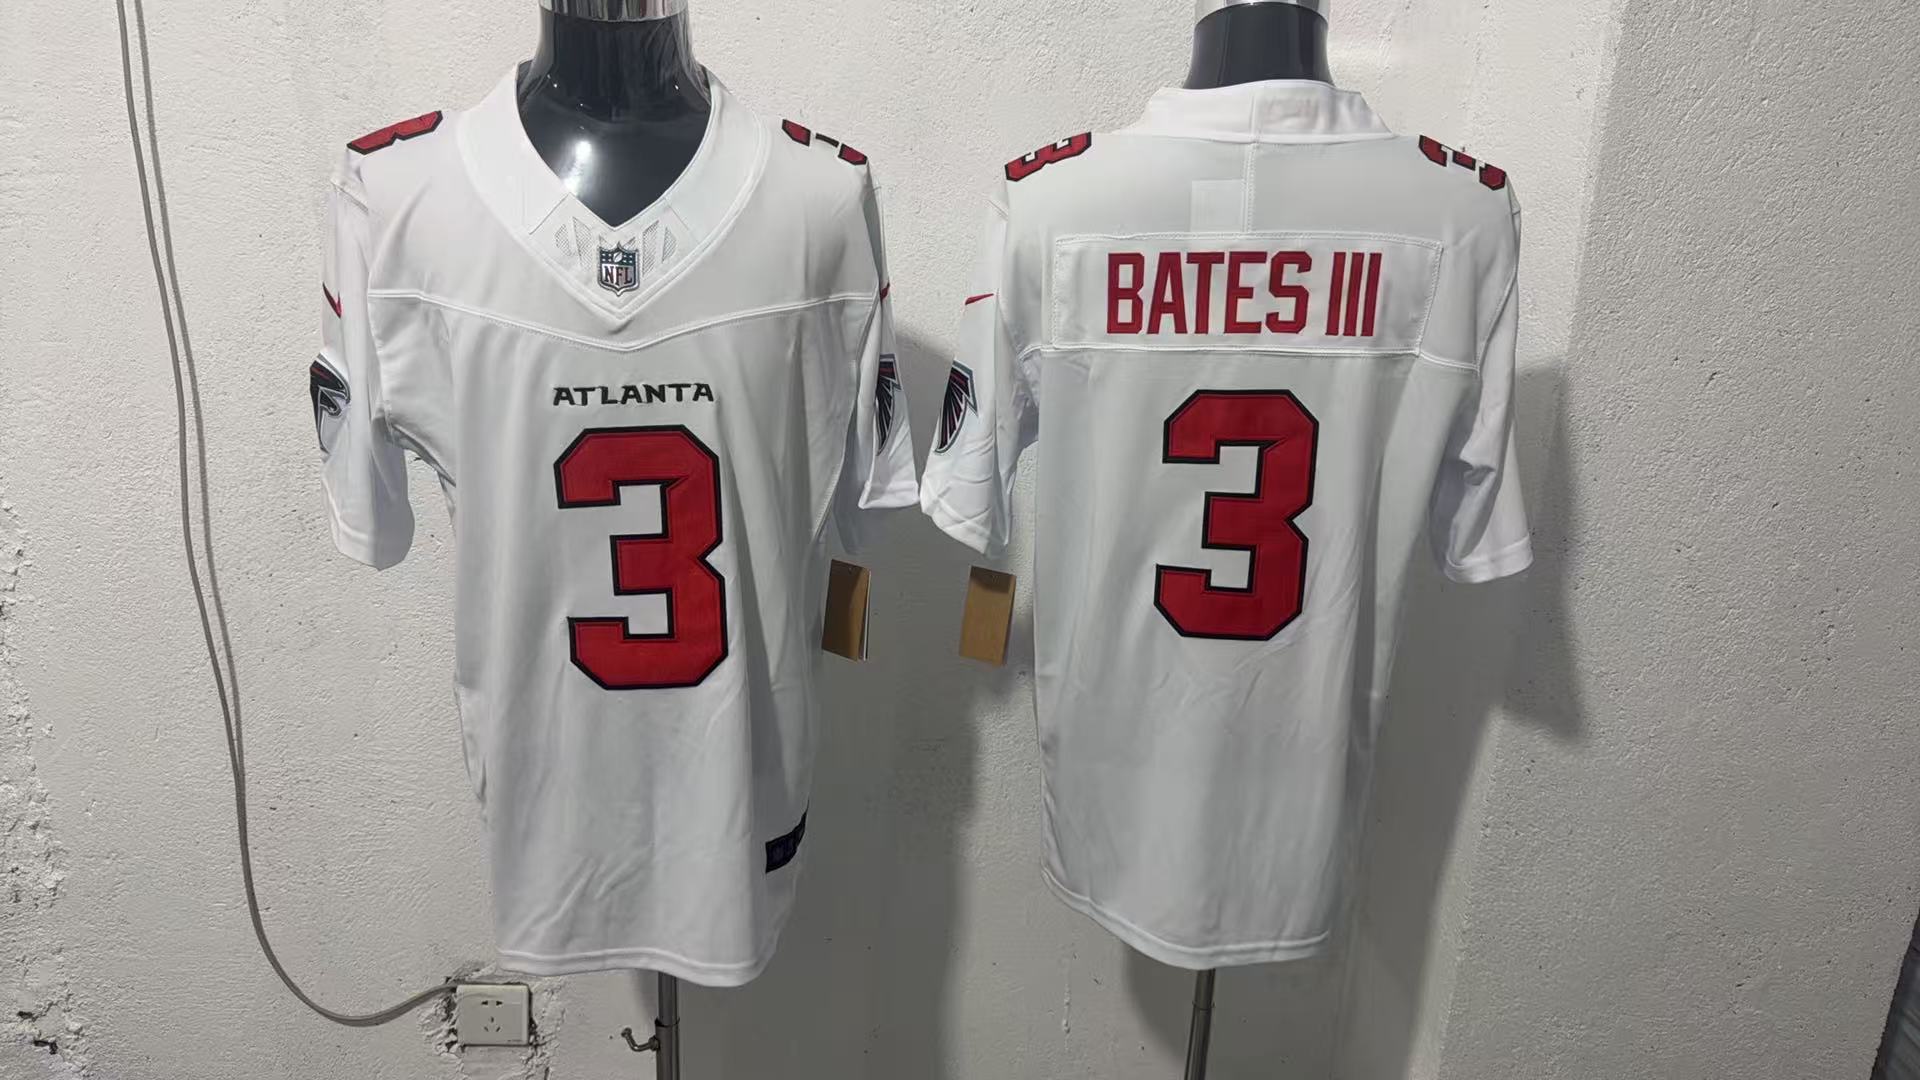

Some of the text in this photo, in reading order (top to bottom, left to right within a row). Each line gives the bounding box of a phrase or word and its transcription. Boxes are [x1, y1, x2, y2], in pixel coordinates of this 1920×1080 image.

[603, 265, 633, 285] NFL
[1106, 250, 1383, 337] BATES III
[552, 382, 715, 407] ATLANTA
[552, 424, 729, 691] 3
[1153, 388, 1320, 641] 3
